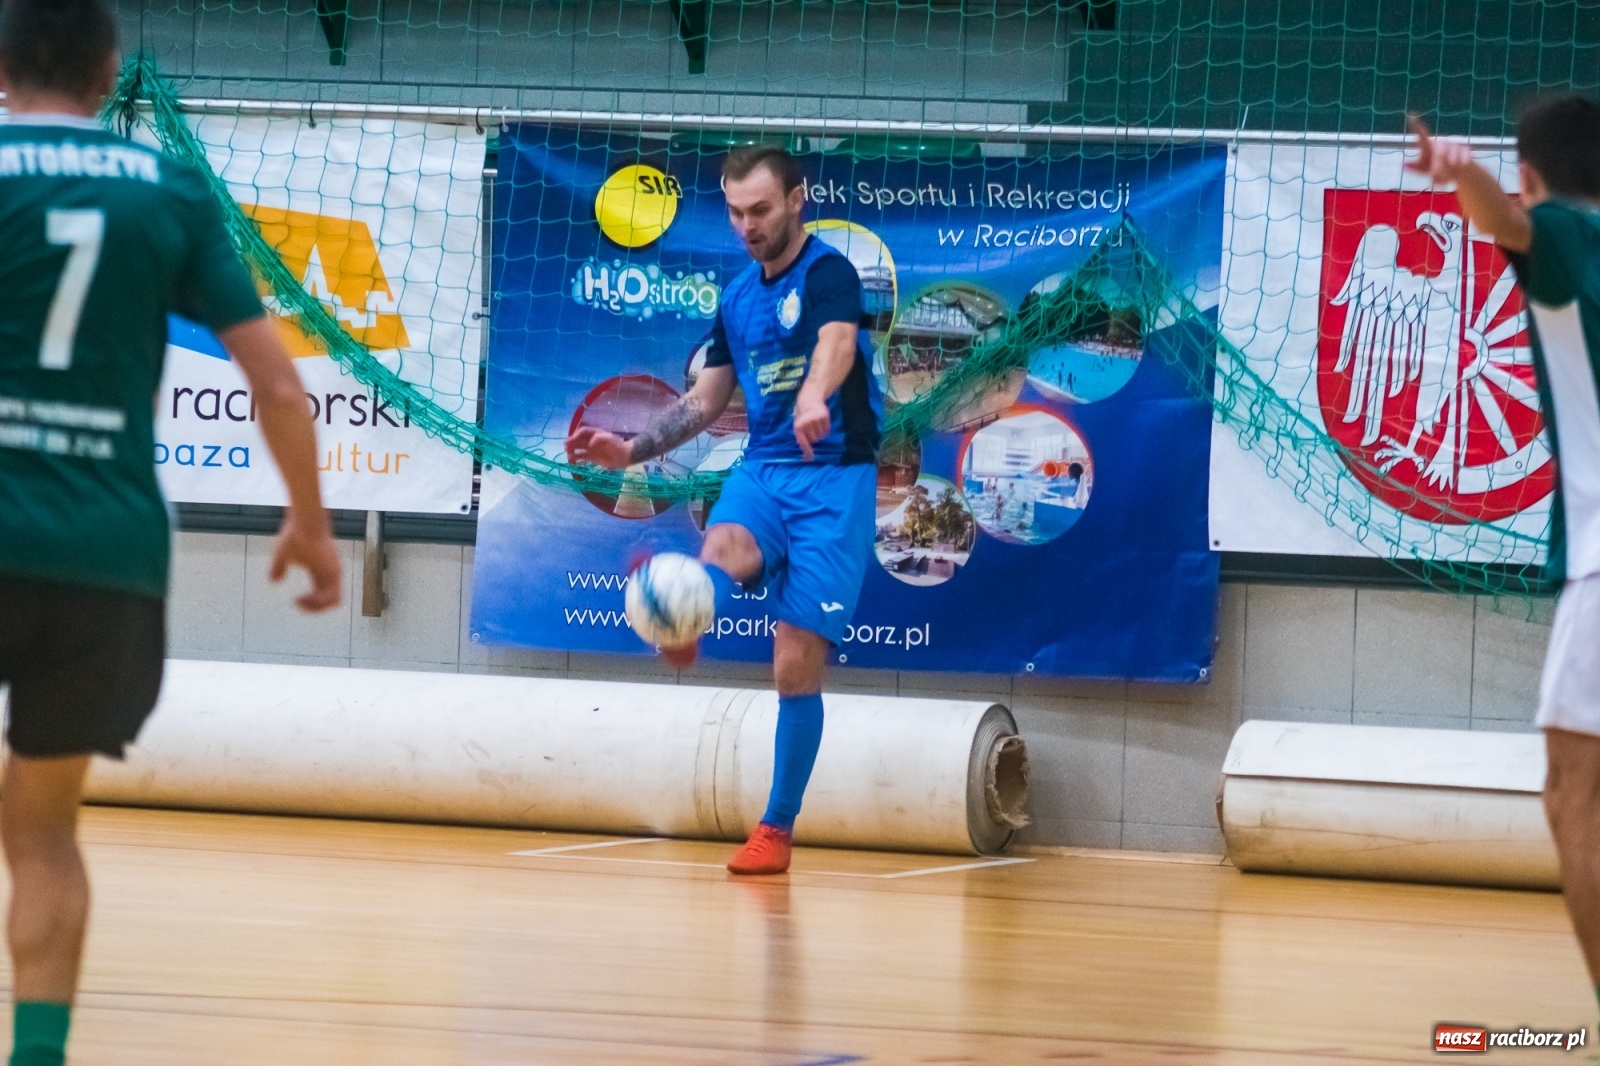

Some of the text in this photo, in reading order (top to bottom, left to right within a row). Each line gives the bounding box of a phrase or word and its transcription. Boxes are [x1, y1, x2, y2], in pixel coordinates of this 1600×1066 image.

[857, 180, 957, 211] Sportu
[968, 183, 975, 207] i
[987, 182, 1130, 213] Rekreacji
[937, 223, 1123, 248] w Raciborzu
[39, 208, 104, 370] 7
[172, 382, 411, 428] racirski
[317, 442, 410, 475] ultur
